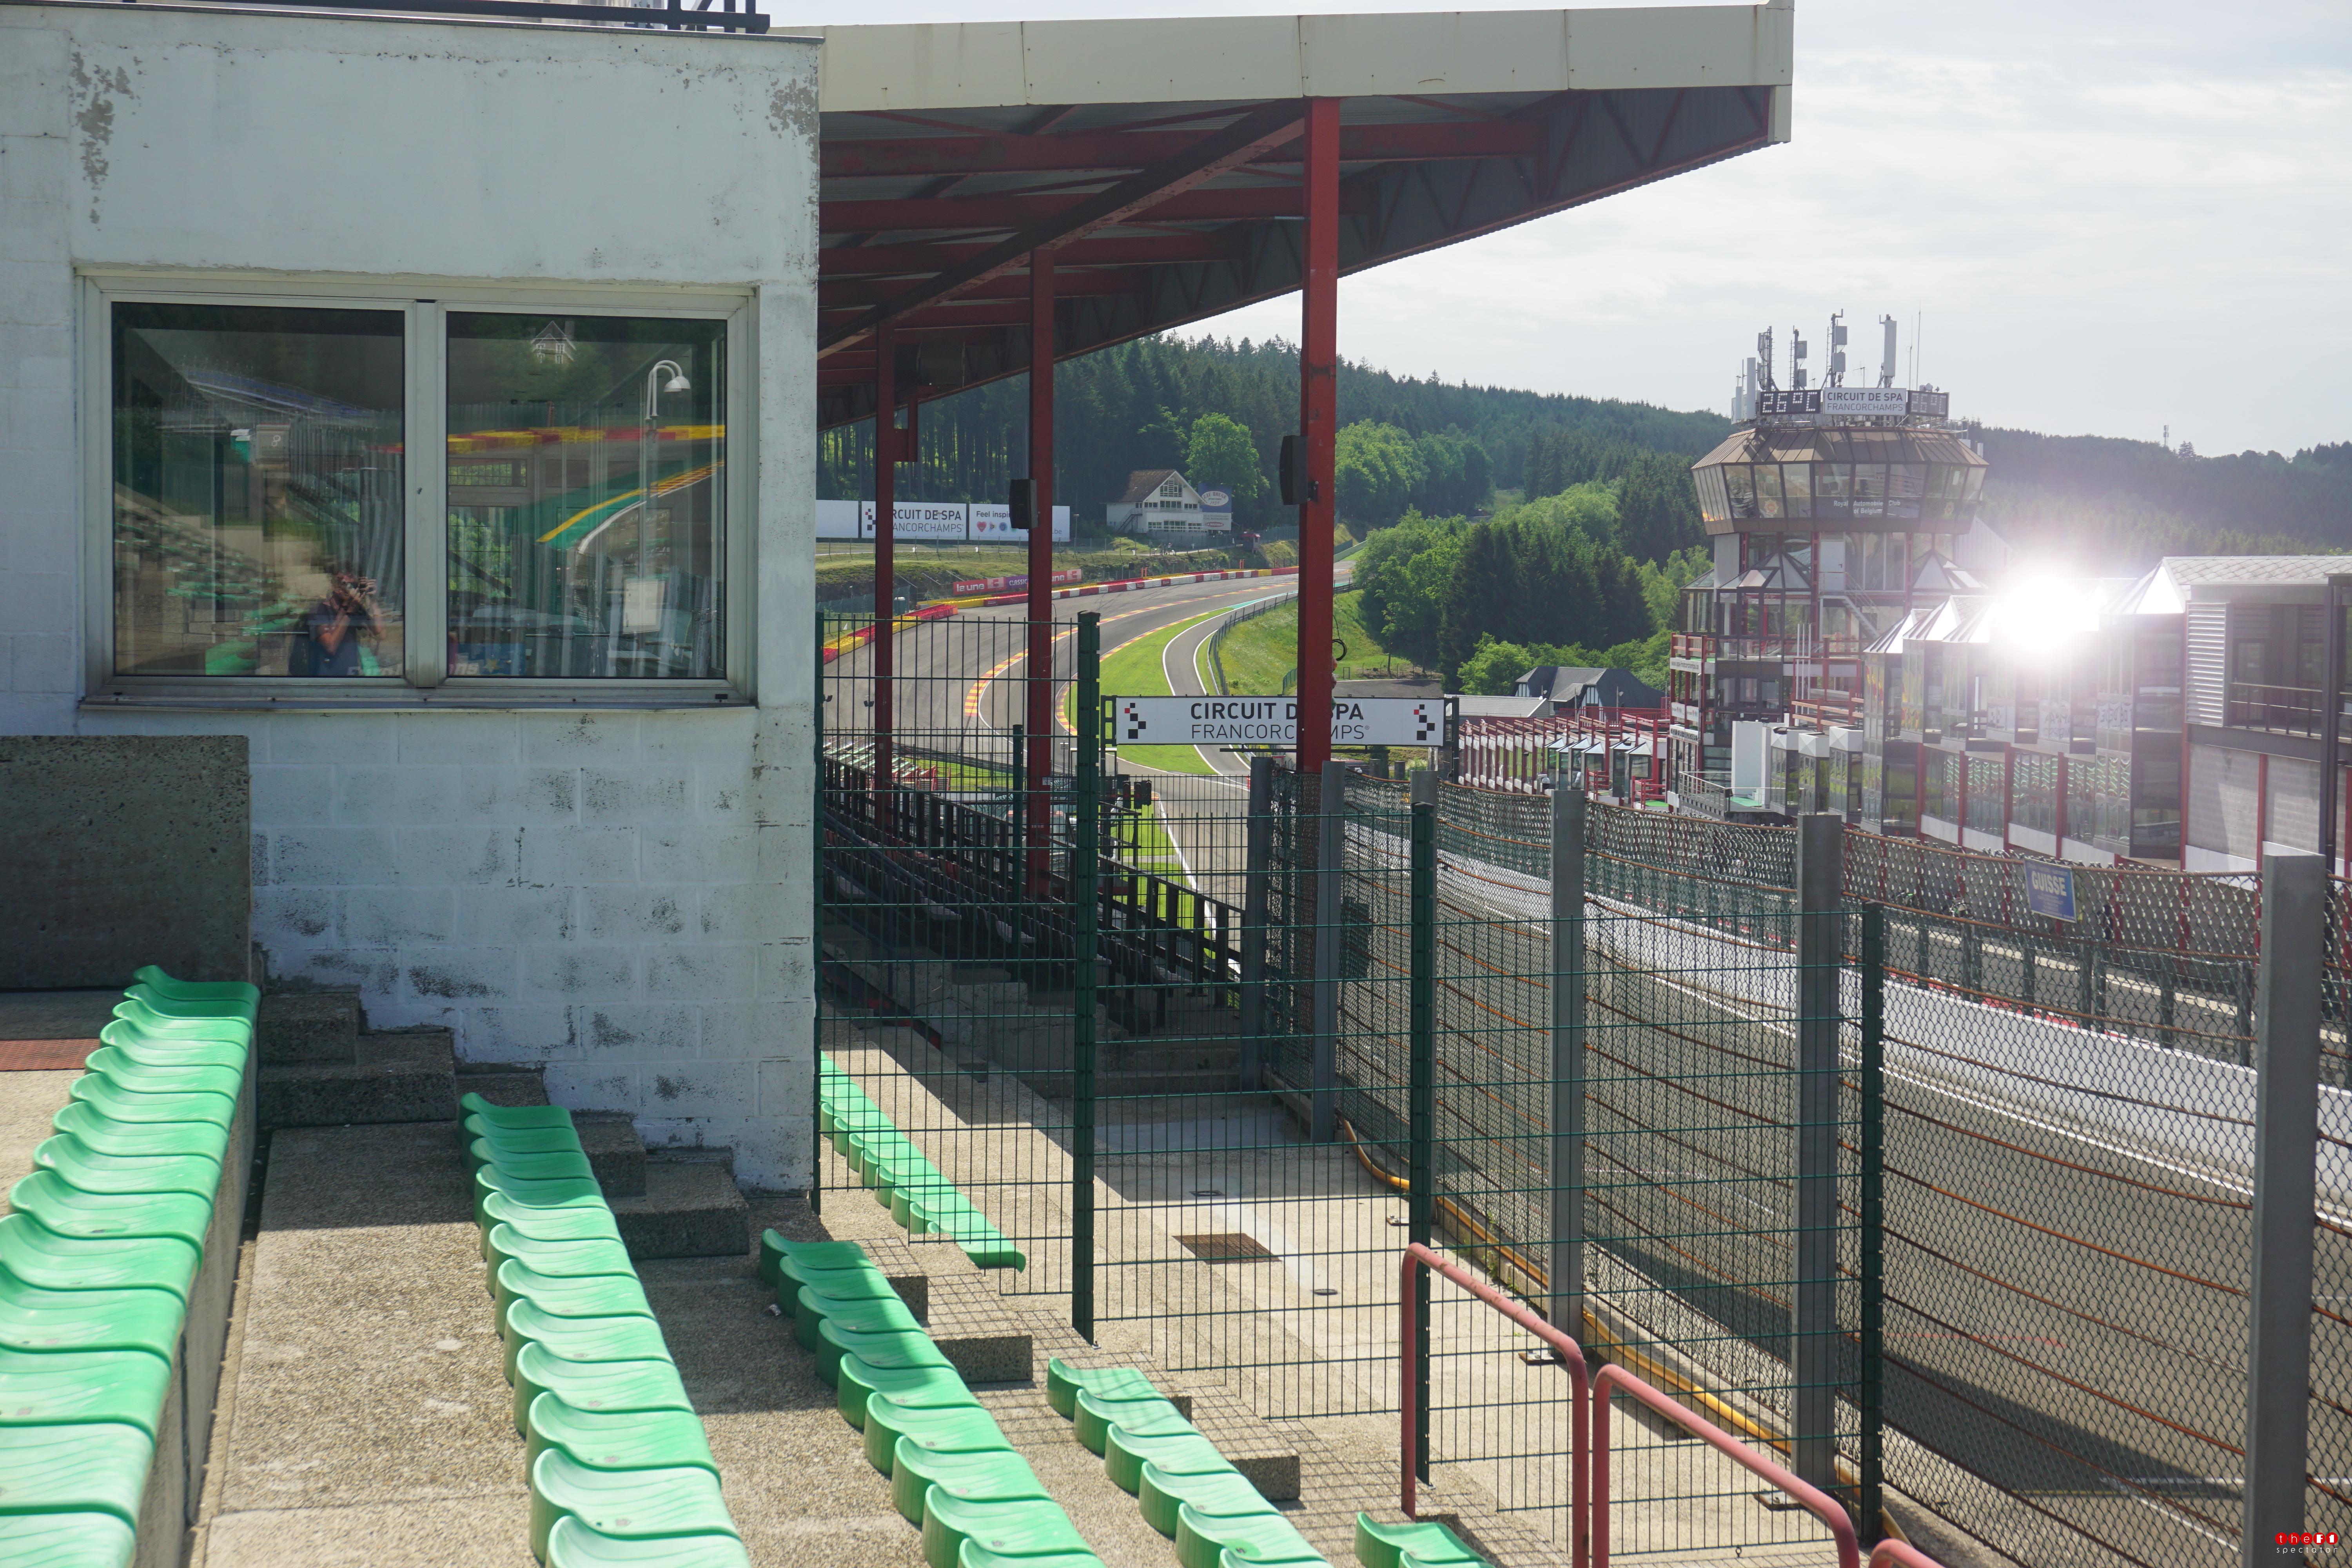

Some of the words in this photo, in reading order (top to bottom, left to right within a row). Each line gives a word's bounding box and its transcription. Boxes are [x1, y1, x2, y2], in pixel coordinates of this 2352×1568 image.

[1762, 392, 1817, 413] 26°C
[1828, 392, 1866, 401] CIRCUIT
[1868, 392, 1881, 401] DE
[1884, 392, 1903, 401] SPA
[893, 509, 921, 520] RCUIT
[925, 510, 938, 520] DE
[942, 510, 962, 521] SPA
[893, 523, 962, 533] ANCORCHAMPS
[956, 584, 965, 592] la
[967, 583, 985, 592] une
[1191, 702, 1276, 720] CIRCUIT
[1286, 703, 1297, 719] D
[1331, 703, 1364, 720] PA
[2031, 871, 2067, 897] GUISSE
